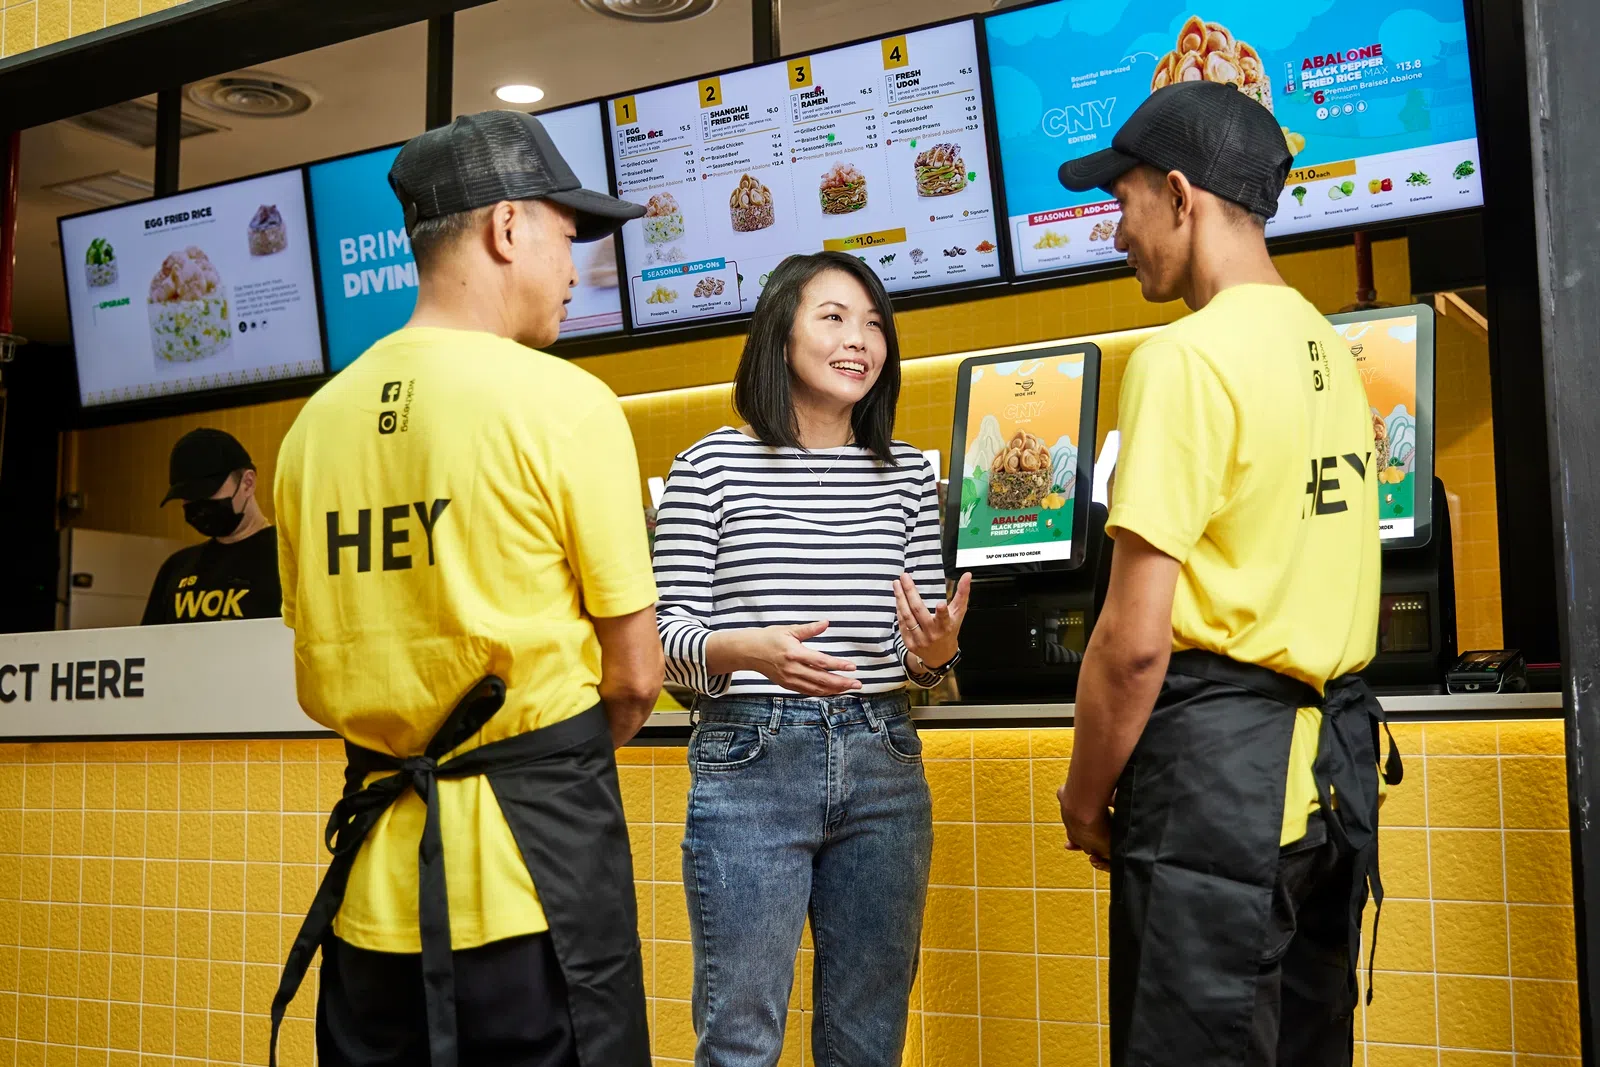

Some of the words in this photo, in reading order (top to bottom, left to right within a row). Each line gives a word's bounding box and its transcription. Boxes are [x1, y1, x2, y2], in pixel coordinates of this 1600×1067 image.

[889, 46, 901, 62] 4
[1301, 44, 1383, 70] ABALONE
[795, 66, 806, 83] 3
[895, 69, 921, 81] FRESH
[1071, 72, 1099, 83] Bountiful
[1100, 65, 1131, 77] Bite-sized
[1301, 66, 1338, 81] BLACK
[1340, 57, 1384, 73] PEPPER
[1396, 59, 1422, 72] $13.8
[896, 78, 920, 89] UDON
[1072, 79, 1097, 89] Abalone
[1302, 77, 1334, 90] FRIED
[1336, 71, 1362, 84] RICE
[1364, 66, 1389, 78] MAX
[705, 86, 716, 102] 2
[800, 89, 825, 100] FRESH
[1313, 90, 1325, 104] 6
[1325, 83, 1358, 95] Premium
[1360, 77, 1388, 89] Braised
[1390, 72, 1423, 83] Abalone
[801, 97, 828, 108] RAMEN
[623, 104, 629, 119] 1
[710, 105, 748, 119] SHANGHAI
[896, 108, 912, 116] Grilled
[913, 104, 934, 113] Chicken
[1042, 96, 1116, 138] CNY
[710, 116, 732, 126] FRIED
[733, 112, 750, 122] RICE
[626, 127, 640, 136] EGG
[816, 123, 836, 131] Chicken
[626, 134, 646, 144] FRIED
[1068, 133, 1096, 144] EDITION
[710, 144, 726, 152] Grilled
[726, 141, 744, 149] Chicken
[641, 158, 658, 166] Chicken
[1295, 170, 1316, 180] $1.0
[144, 218, 163, 229] EGG
[164, 212, 190, 225] FRIED
[191, 207, 212, 220] RICE
[1033, 211, 1074, 223] SEASONAL
[1083, 203, 1120, 214] ADD-ONs
[856, 235, 873, 246] $1.0
[647, 268, 682, 278] SEASONAL
[688, 261, 720, 272] ADD-ONs
[99, 297, 130, 309] UPGRADE
[1003, 400, 1046, 420] CNY
[1301, 452, 1372, 520] HEY
[991, 523, 1012, 531] BLACK
[1013, 521, 1038, 529] PEPPER
[992, 514, 1038, 525] ABALONE
[326, 498, 452, 576] HEY
[175, 588, 250, 619] WOK
[50, 658, 145, 702] HERE
